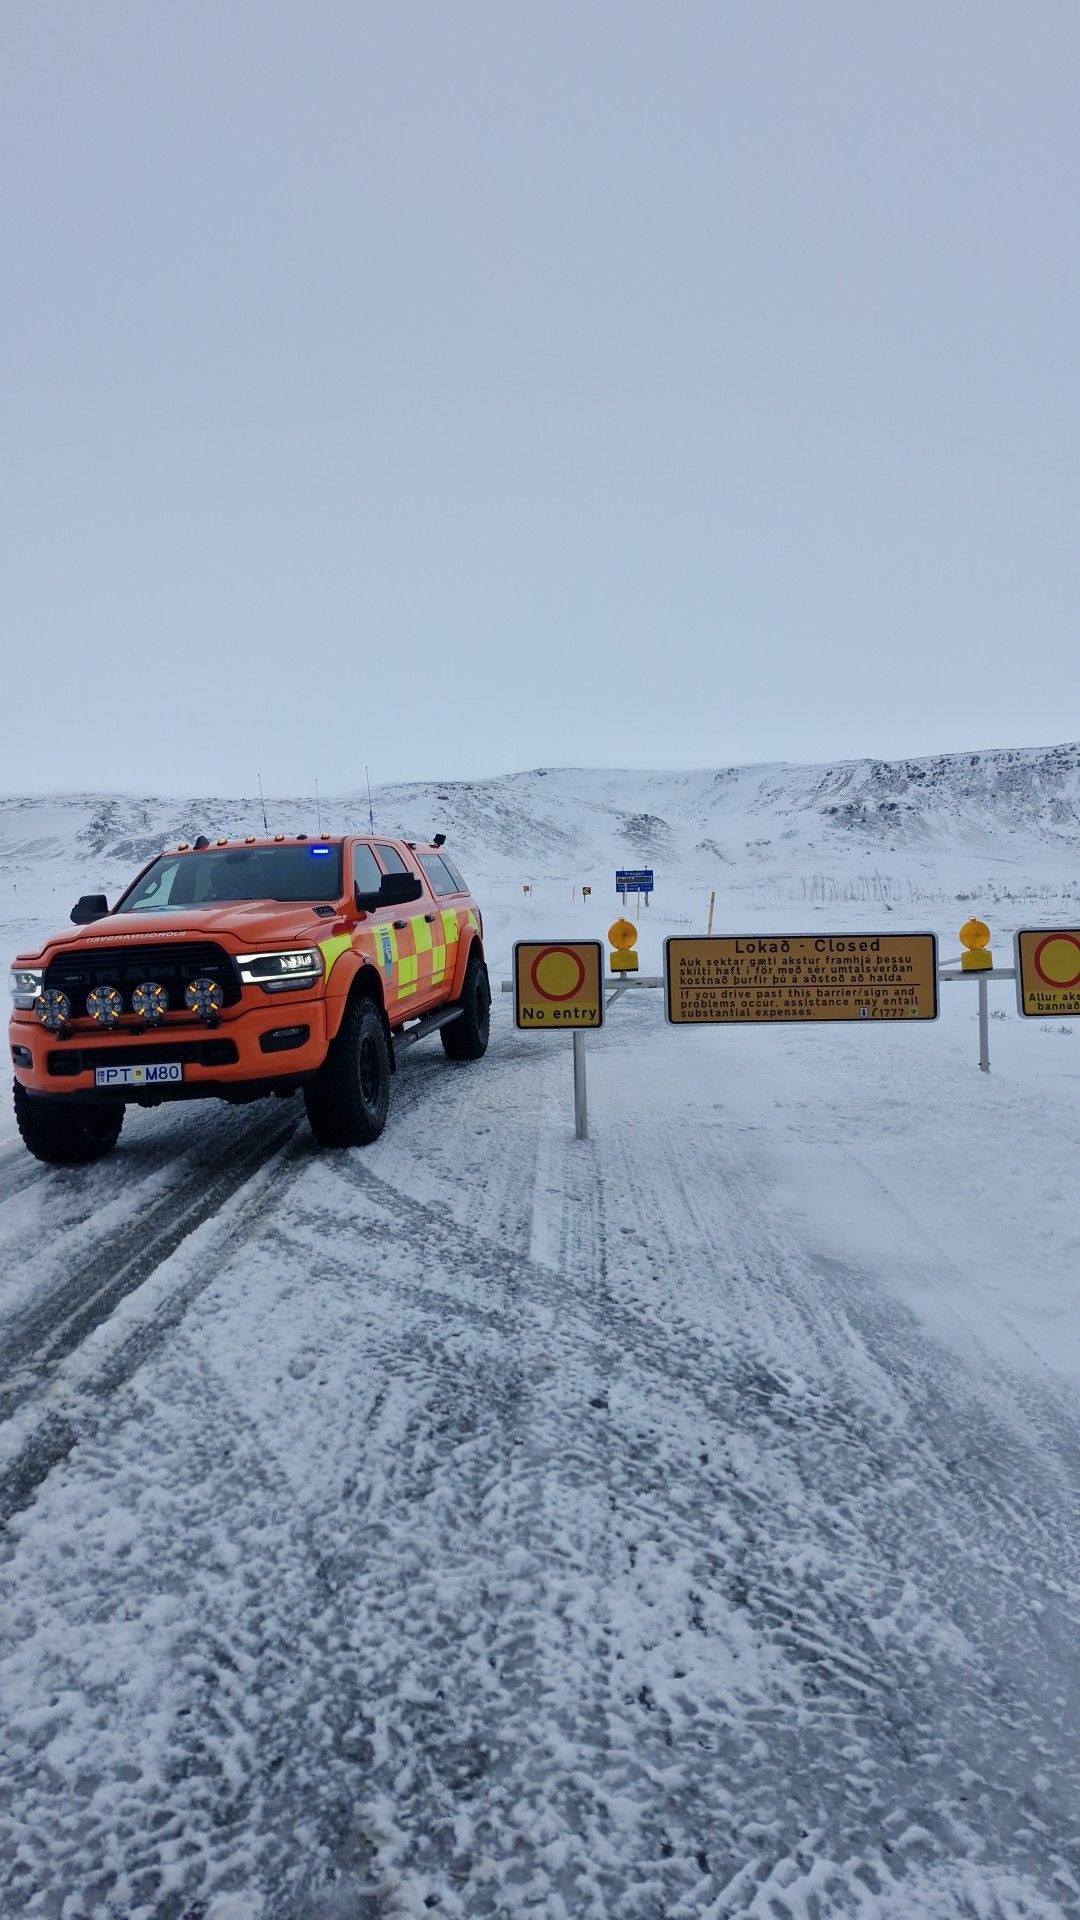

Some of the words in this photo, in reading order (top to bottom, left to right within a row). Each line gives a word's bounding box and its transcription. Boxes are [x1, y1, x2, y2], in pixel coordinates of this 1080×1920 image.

[735, 939, 790, 953] Lokað
[815, 939, 880, 952] Closed
[679, 957, 702, 966] Auk
[706, 957, 745, 966] sektar
[750, 957, 776, 967] gæti
[782, 956, 820, 965] akstur
[825, 955, 871, 966] framhjá
[876, 955, 911, 965] þessu
[679, 967, 711, 976] skilti
[716, 967, 741, 975] haft
[755, 966, 772, 974] för
[778, 965, 802, 974] með
[807, 965, 826, 974] sér
[830, 964, 913, 974] umtalsverðan
[680, 975, 728, 985] kostnað
[733, 975, 768, 985] þurfir
[773, 974, 786, 985] þú
[803, 974, 845, 983] aðstoð
[850, 974, 864, 982] að
[869, 973, 907, 982] halda.
[680, 990, 690, 999] If
[695, 991, 716, 1000] you
[721, 989, 751, 999] drive
[756, 989, 783, 1001] past
[788, 988, 811, 998] this
[816, 988, 889, 998] barrier/sign
[894, 987, 915, 996] and
[1029, 992, 1057, 1001] Allur
[680, 1000, 736, 1009] problems
[783, 998, 849, 1007] assistance
[854, 998, 878, 1007] may
[883, 996, 920, 1006] entail
[522, 1007, 545, 1020] No
[553, 1007, 597, 1021] entry
[681, 1009, 751, 1018] substantial
[755, 1008, 816, 1018] expenses.
[880, 1008, 905, 1017] 1777
[106, 1068, 132, 1083] PT
[145, 1065, 179, 1080] M80
